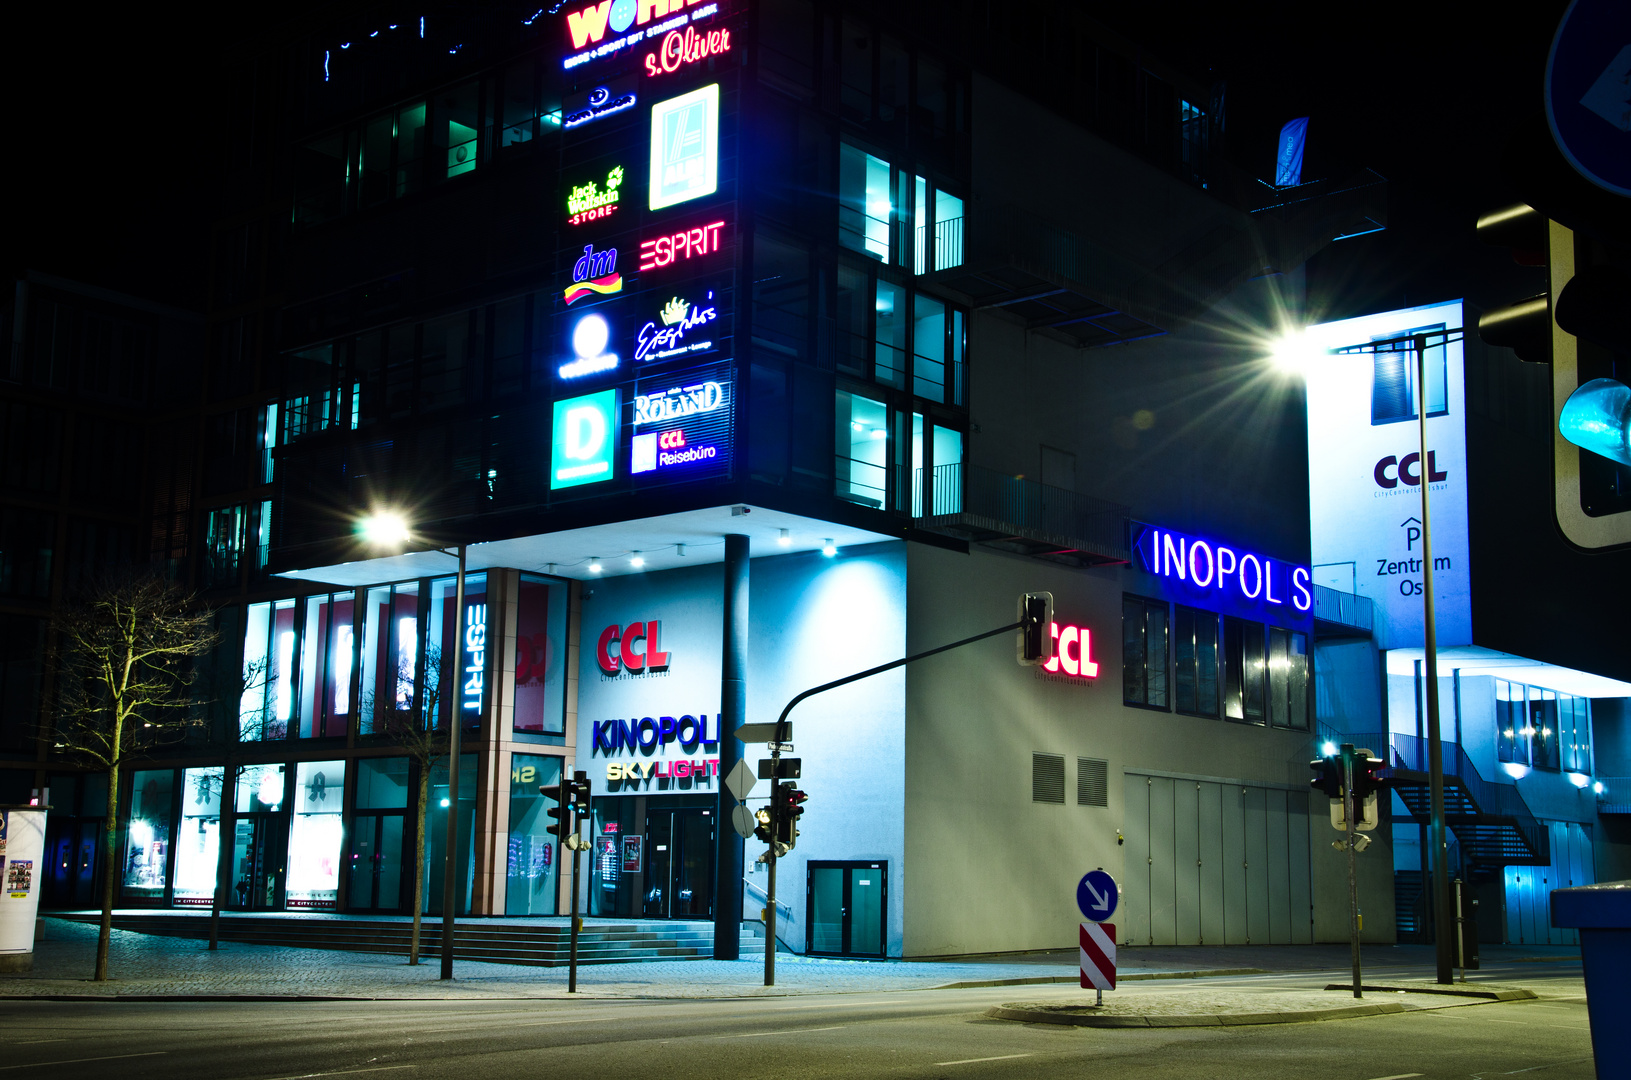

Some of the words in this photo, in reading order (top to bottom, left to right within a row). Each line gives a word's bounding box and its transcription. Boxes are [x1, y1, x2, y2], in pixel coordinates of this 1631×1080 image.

[645, 26, 730, 77] s.Oliver
[568, 181, 597, 200] Jack
[568, 189, 619, 214] Wolfskin
[640, 221, 724, 270] ESPRIT
[573, 244, 617, 282] dm
[565, 406, 605, 460] D
[660, 430, 685, 449] CCL
[659, 445, 716, 466] Reisebüro
[1374, 450, 1448, 489] CCL
[1374, 483, 1448, 498] CityCenterLashut
[1407, 527, 1421, 551] P
[1377, 557, 1451, 576] Zentrm
[1400, 579, 1424, 596] Os
[597, 620, 671, 671] CCL
[463, 603, 487, 715] ESPRIT
[606, 759, 720, 781] SKYLIGHT
